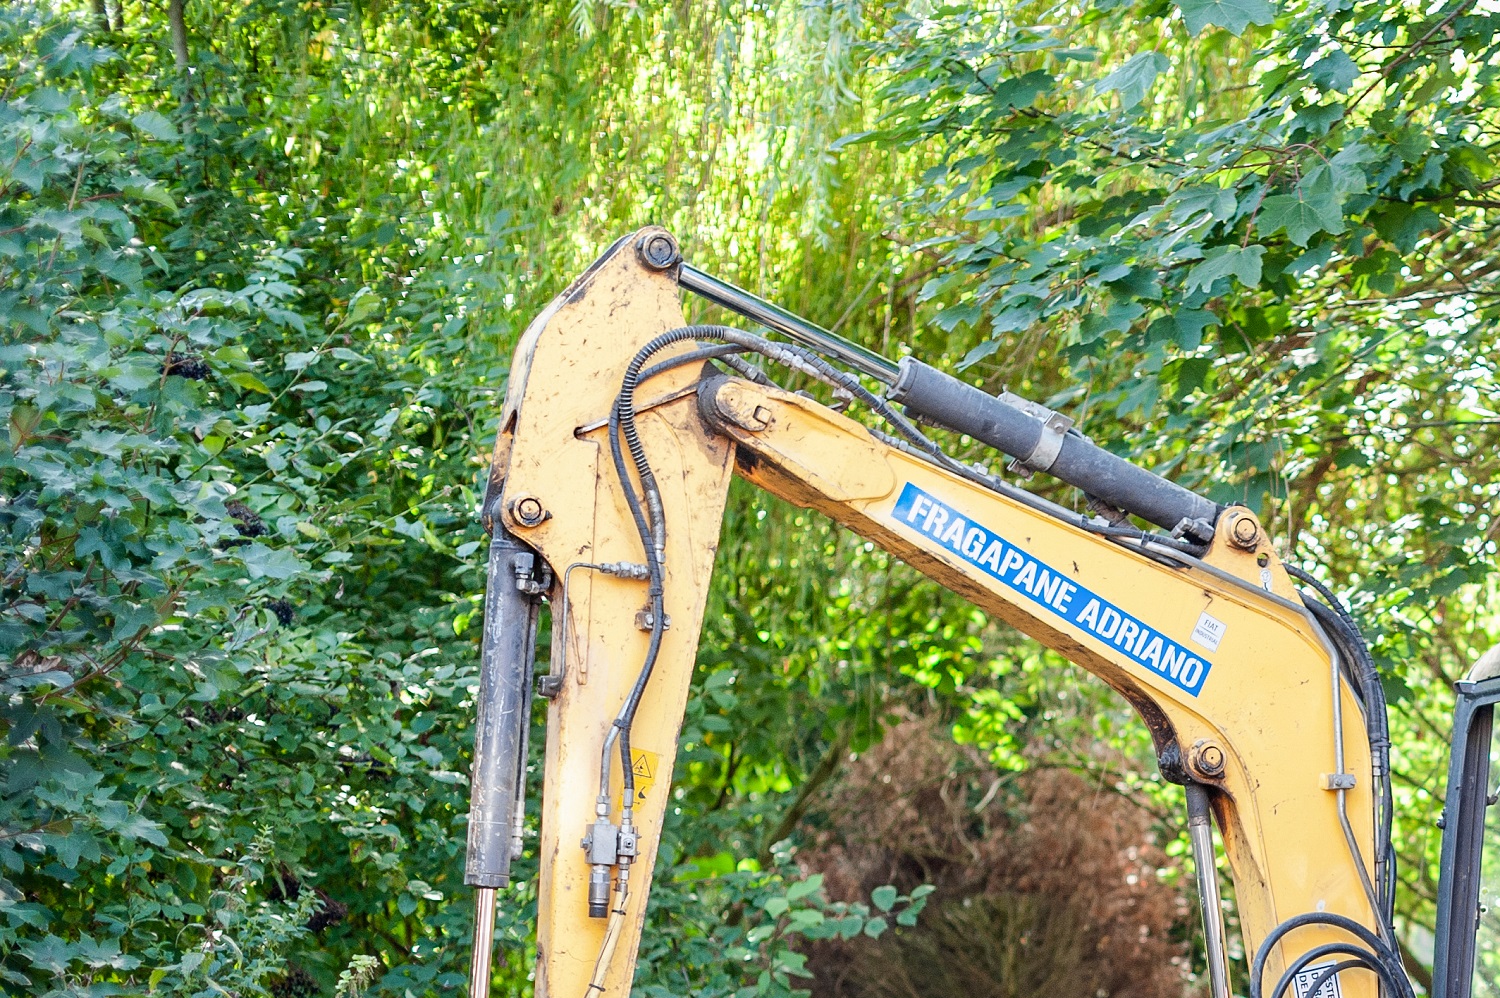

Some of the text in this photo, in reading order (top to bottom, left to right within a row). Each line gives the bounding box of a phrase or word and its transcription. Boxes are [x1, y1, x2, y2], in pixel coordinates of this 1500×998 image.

[906, 493, 1205, 689] FRAGAPANE ADRIANO
[1203, 619, 1218, 632] FIAT
[1299, 975, 1308, 989] DE
